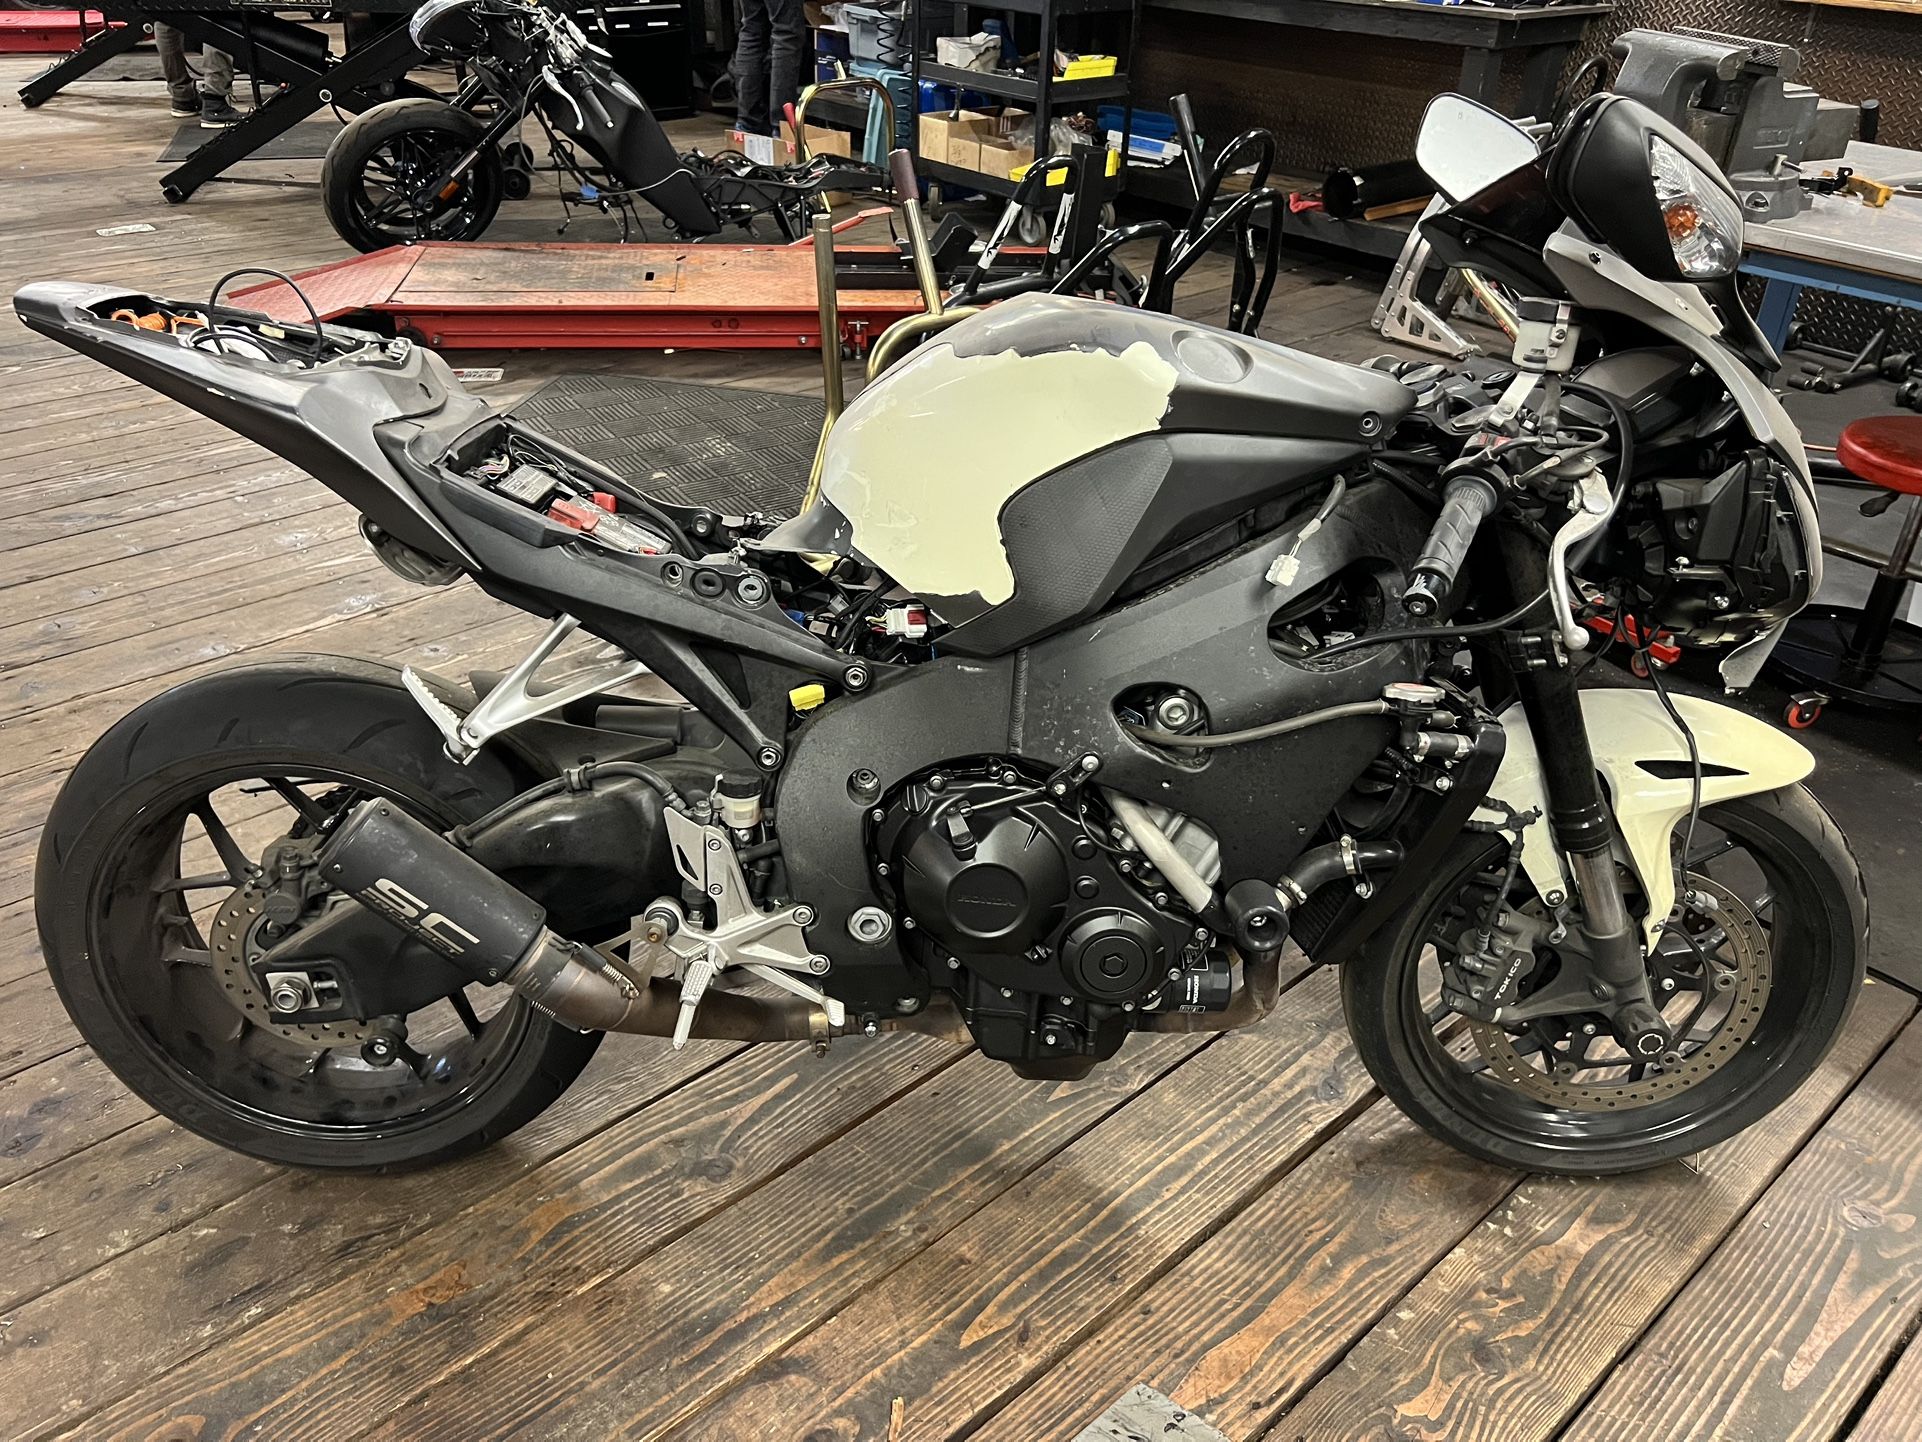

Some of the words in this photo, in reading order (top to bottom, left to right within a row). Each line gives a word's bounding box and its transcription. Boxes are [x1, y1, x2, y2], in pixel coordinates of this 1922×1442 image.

[359, 888, 462, 956] PROJECT
[374, 878, 481, 953] SC
[1494, 958, 1522, 1000] TOKICO
